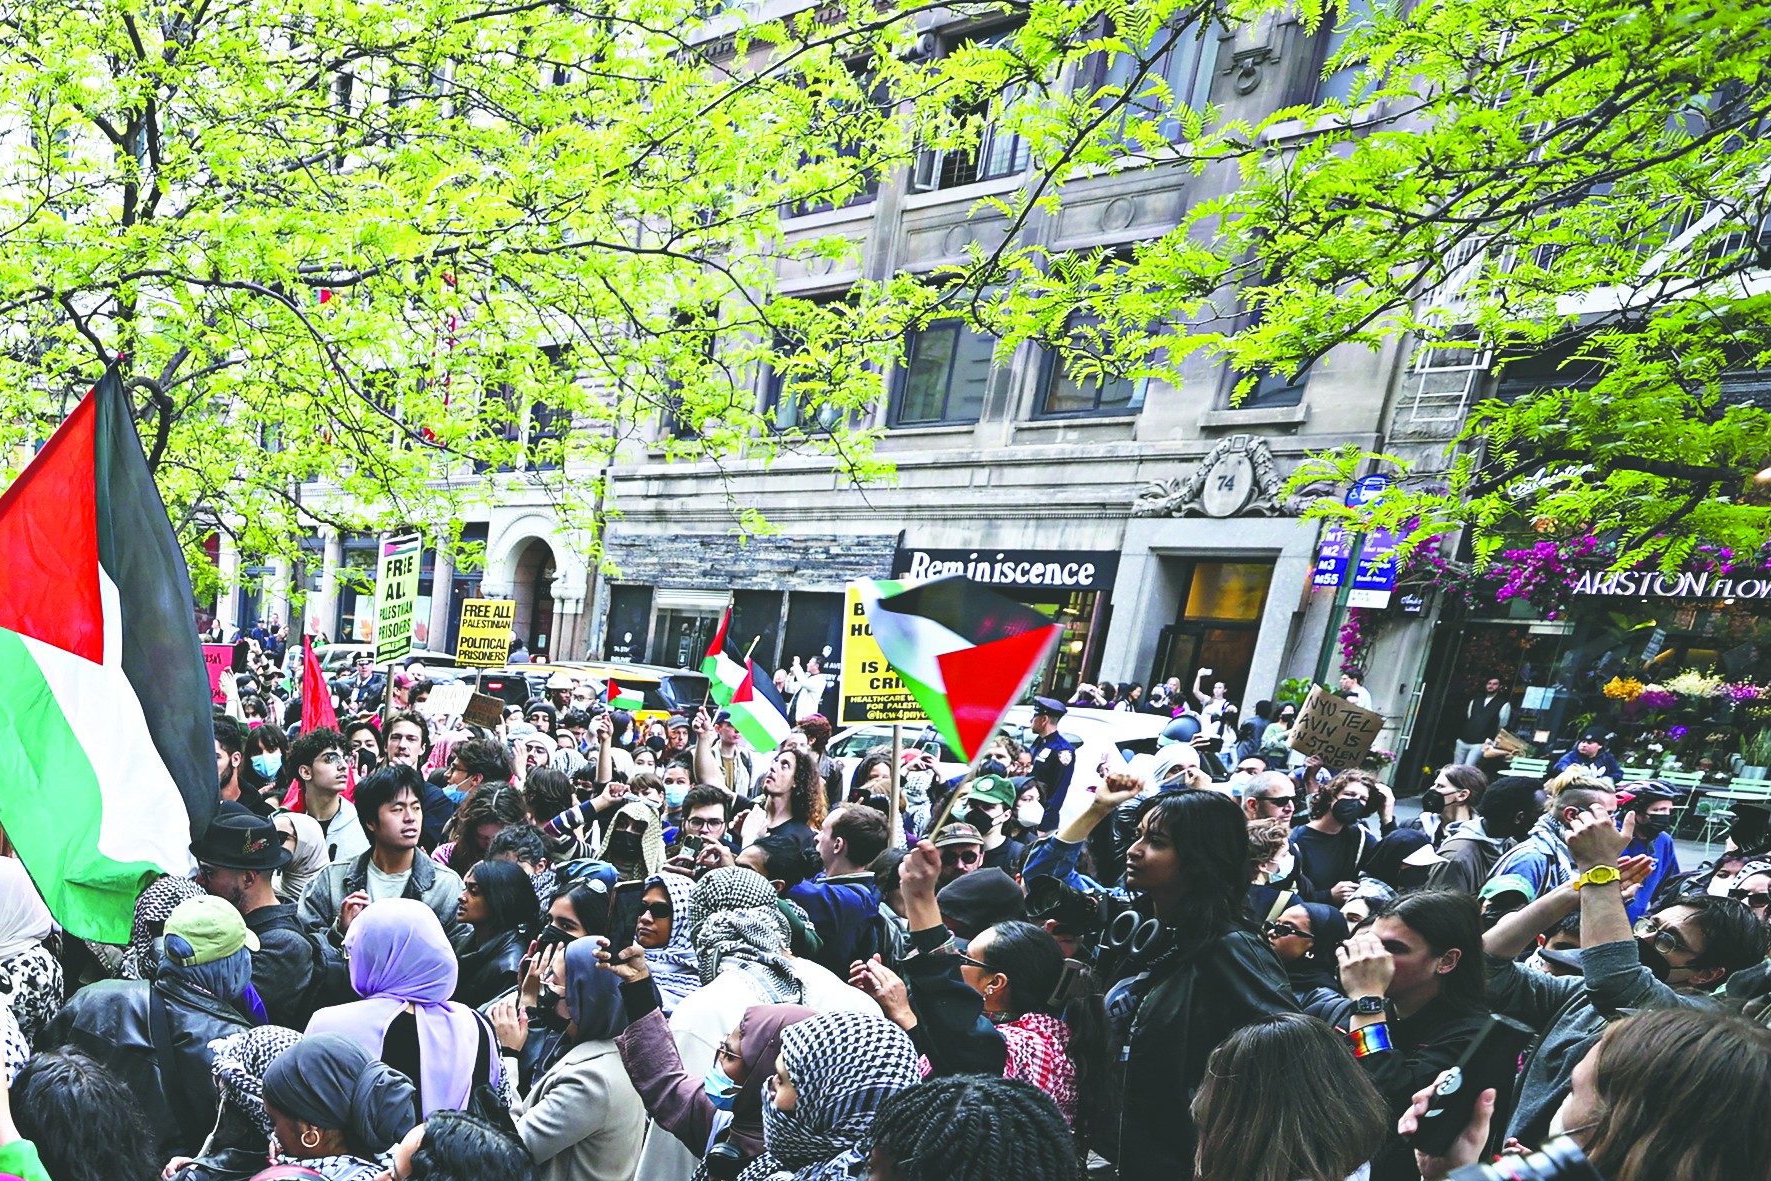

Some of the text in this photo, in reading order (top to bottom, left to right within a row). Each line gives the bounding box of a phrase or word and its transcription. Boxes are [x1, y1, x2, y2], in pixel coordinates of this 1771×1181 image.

[1218, 475, 1235, 491] 74
[1322, 546, 1339, 556] M2
[909, 551, 1095, 585] Reminiscence
[1319, 559, 1335, 569] M3
[1314, 573, 1338, 584] M55
[1573, 570, 1709, 597] ARISTON
[464, 605, 511, 618] FREE ALL
[462, 619, 510, 628] PALESTINIAN
[460, 637, 506, 649] POLITICAL
[458, 650, 506, 661] PRISONERS
[862, 662, 878, 673] IS
[870, 678, 906, 689] CRI
[1306, 696, 1373, 733] NYU TEL
[1344, 732, 1360, 747] IS
[1306, 736, 1361, 761] STOLEN
